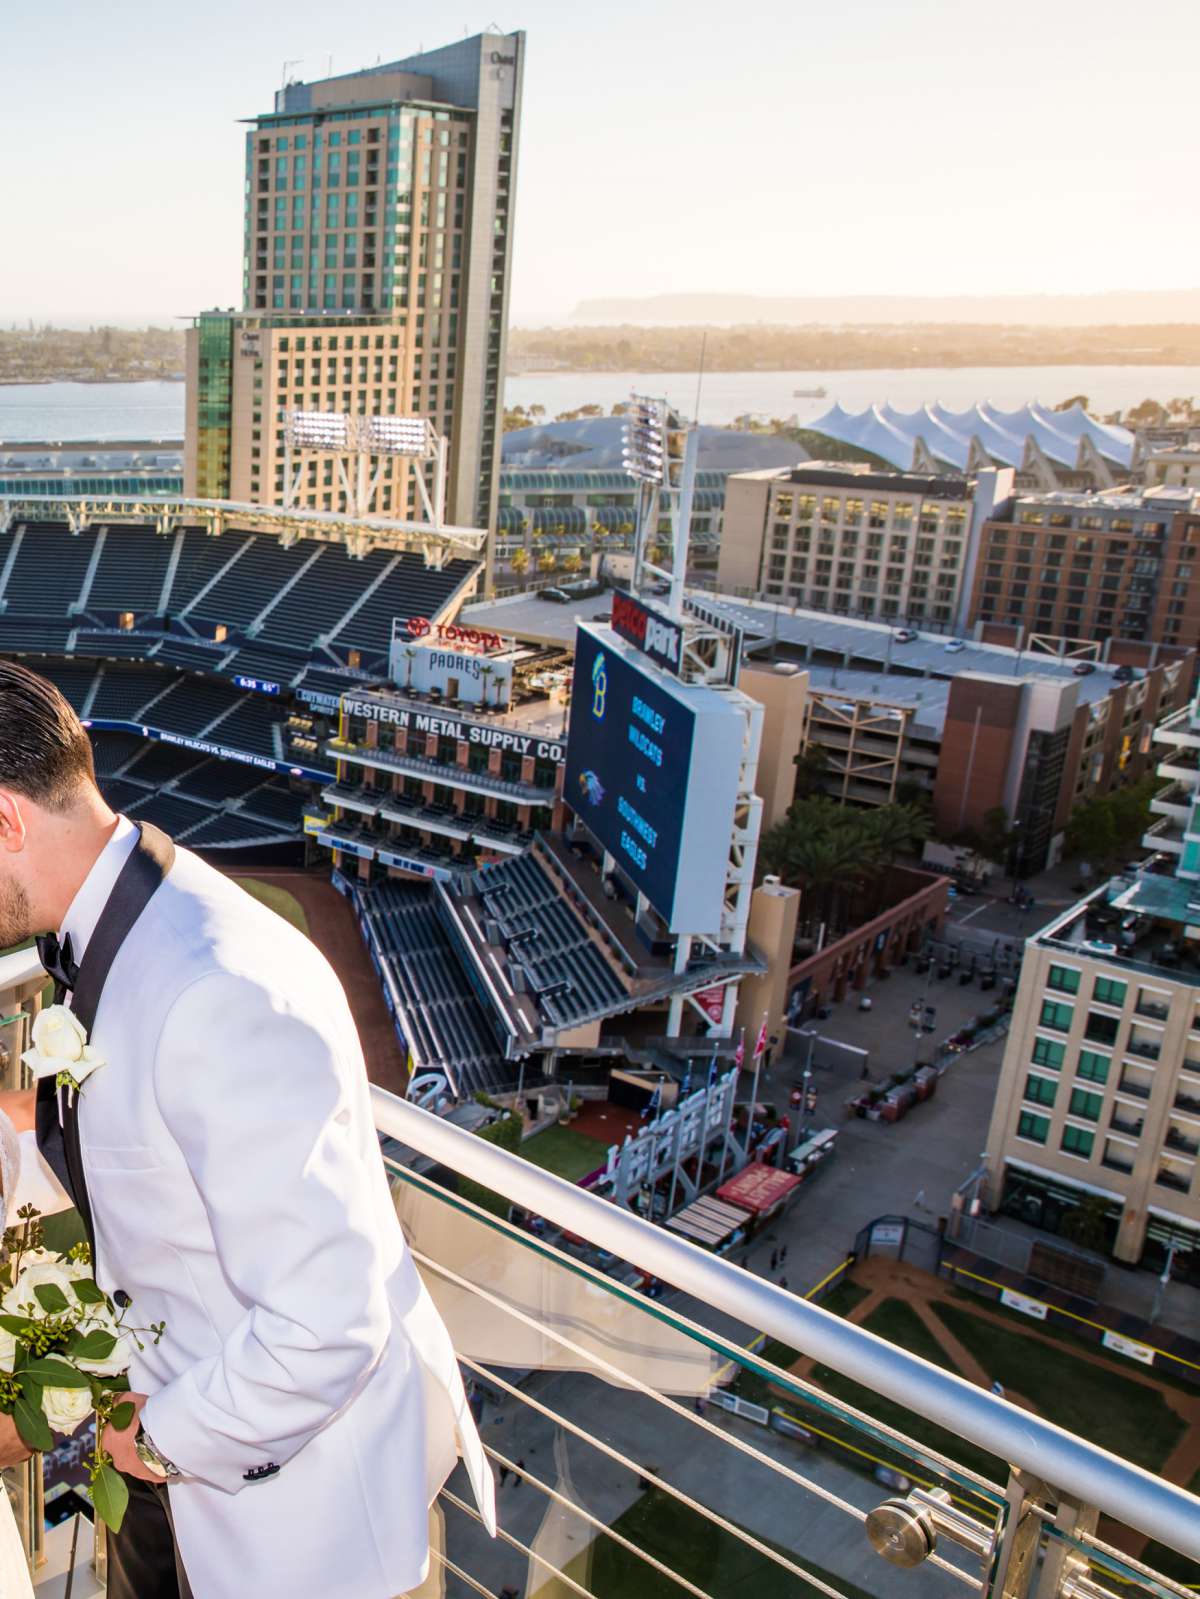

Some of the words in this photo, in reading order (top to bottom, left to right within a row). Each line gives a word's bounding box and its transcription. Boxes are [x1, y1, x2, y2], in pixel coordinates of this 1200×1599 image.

[436, 624, 503, 649] TOYOTA
[644, 616, 679, 663] park
[429, 653, 480, 680] PADRES
[343, 699, 410, 727] WESTERN
[416, 715, 465, 739] METAL
[469, 727, 532, 754] SUPPLY
[537, 742, 566, 762] CO.
